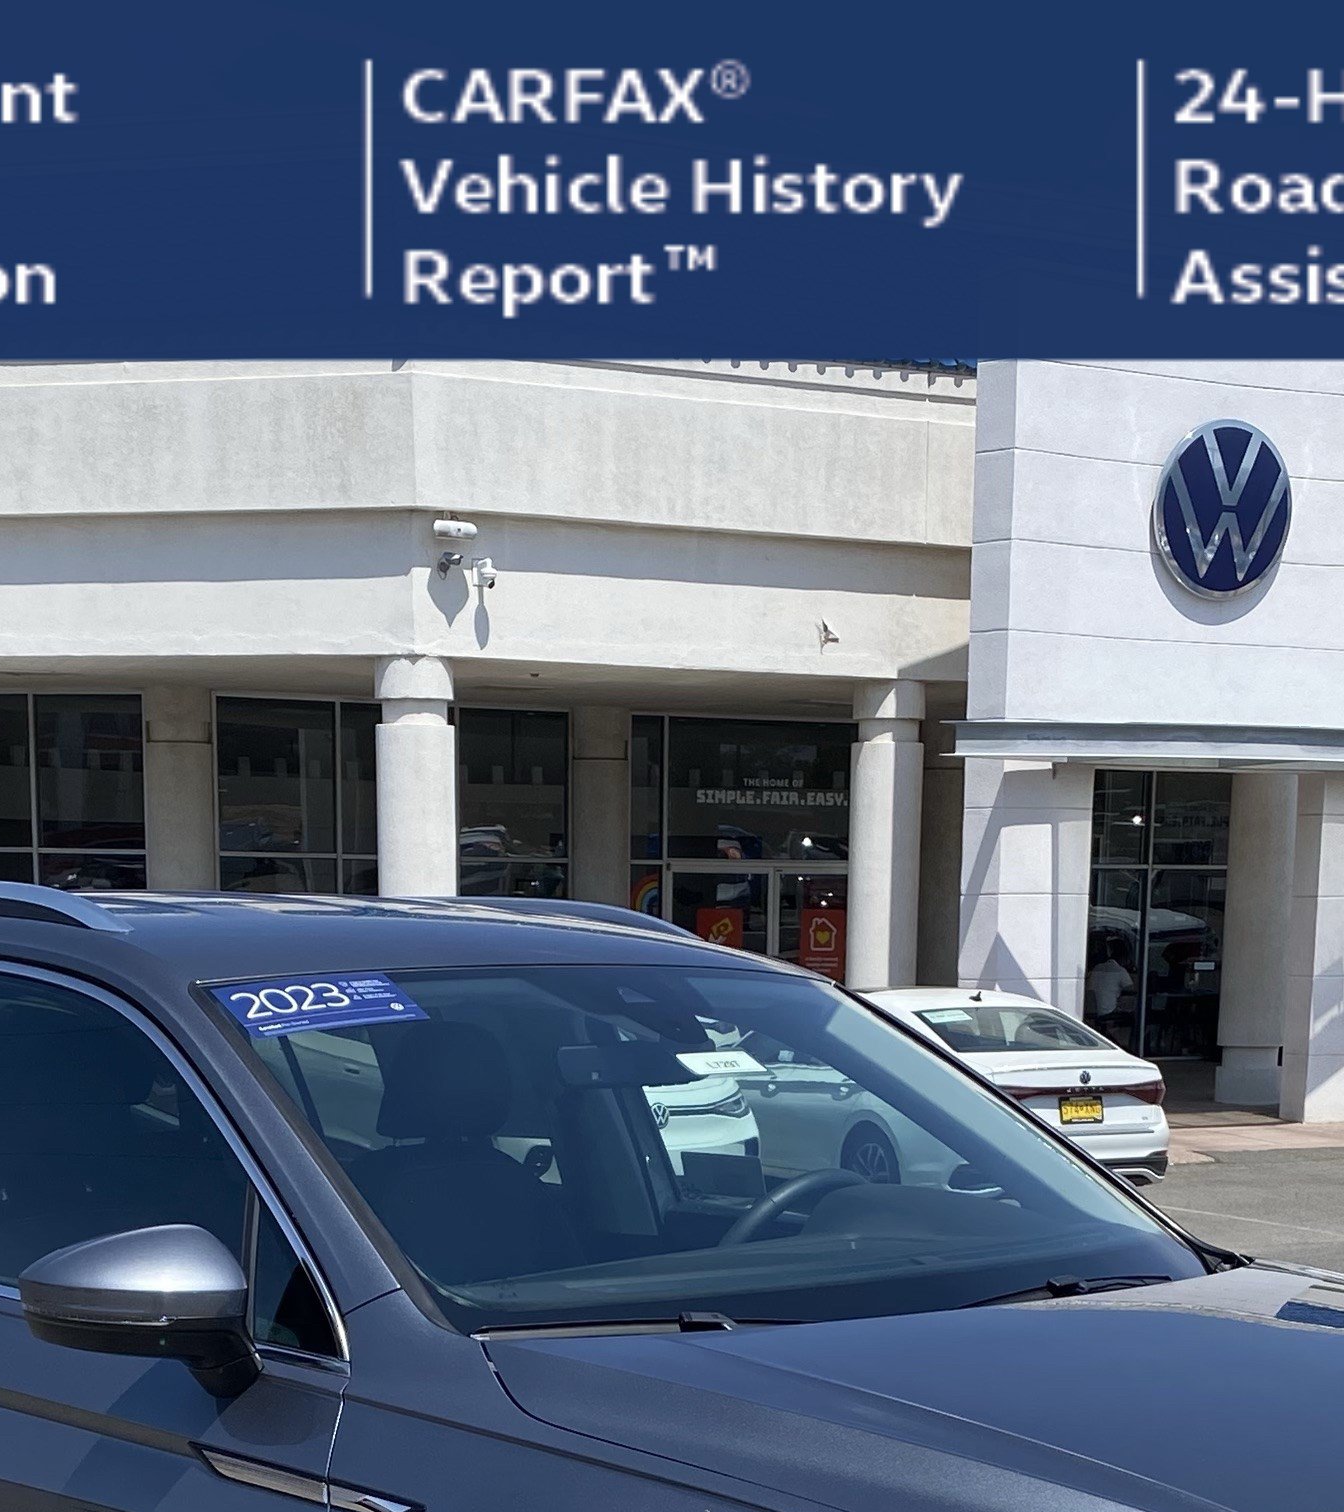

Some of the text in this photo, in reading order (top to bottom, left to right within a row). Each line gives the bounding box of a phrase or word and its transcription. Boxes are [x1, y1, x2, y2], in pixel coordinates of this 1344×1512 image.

[1157, 420, 1291, 596] VW
[742, 777, 805, 788] THE HOME OF
[229, 981, 351, 1020] 2023
